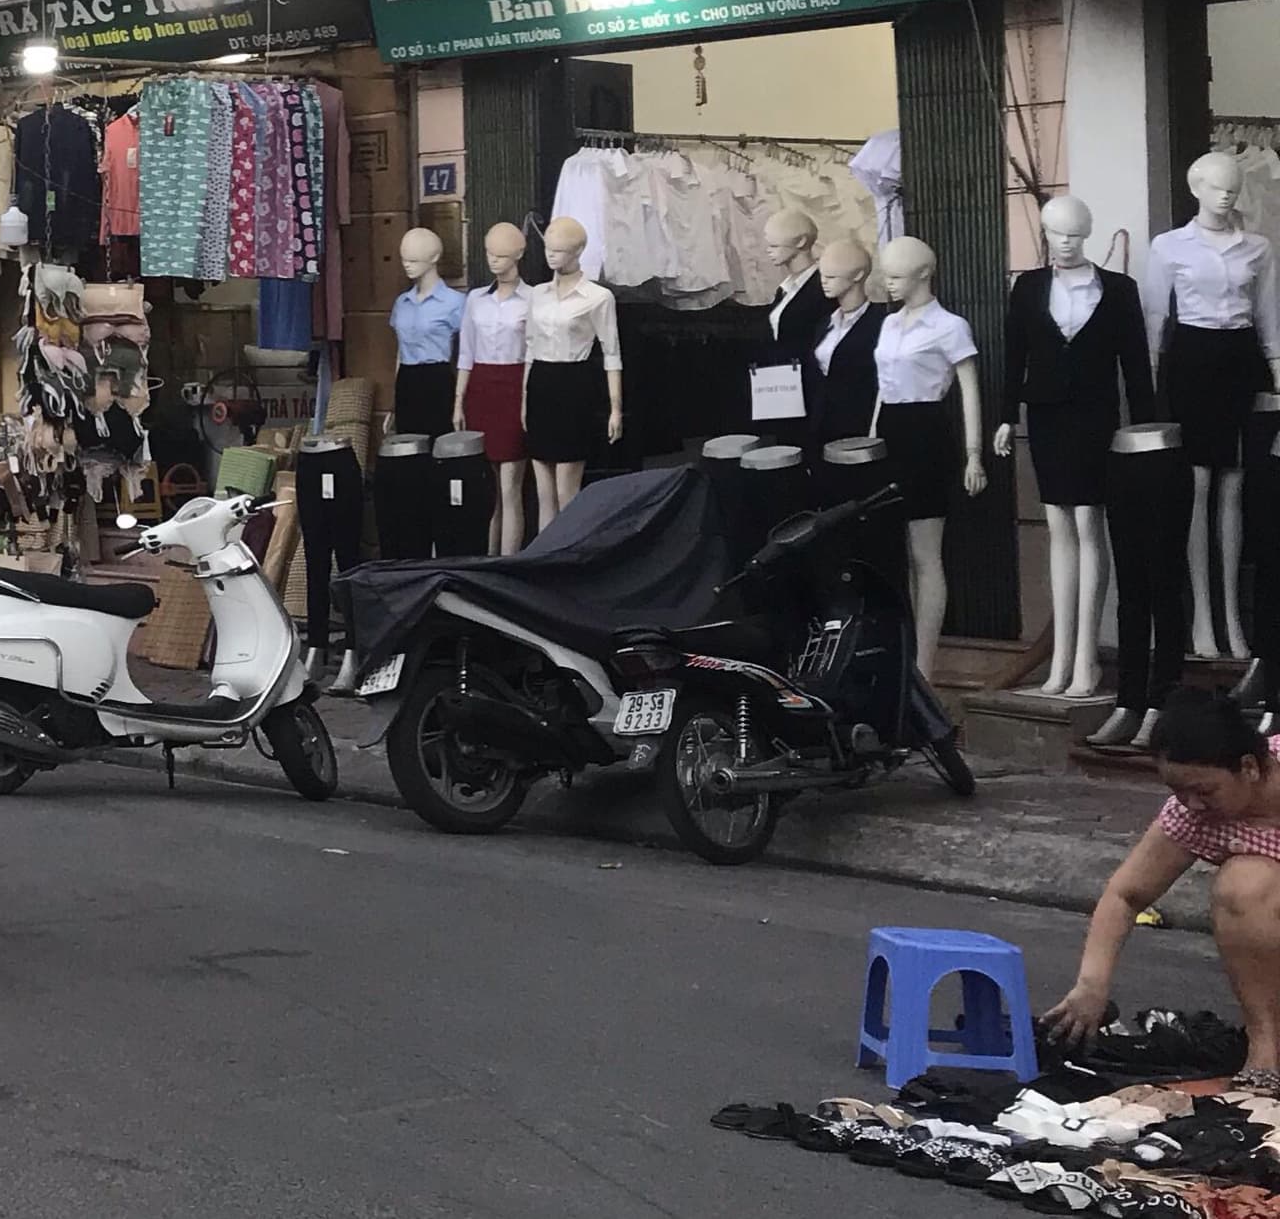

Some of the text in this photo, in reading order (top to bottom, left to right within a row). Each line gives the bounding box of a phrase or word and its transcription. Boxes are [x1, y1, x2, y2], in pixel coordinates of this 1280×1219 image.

[732, 1, 764, 22] DỊCH
[154, 22, 185, 39] hoa
[453, 37, 484, 51] PHAN
[487, 31, 512, 48] VĂN
[429, 169, 449, 190] 47
[624, 711, 662, 730] 9233
